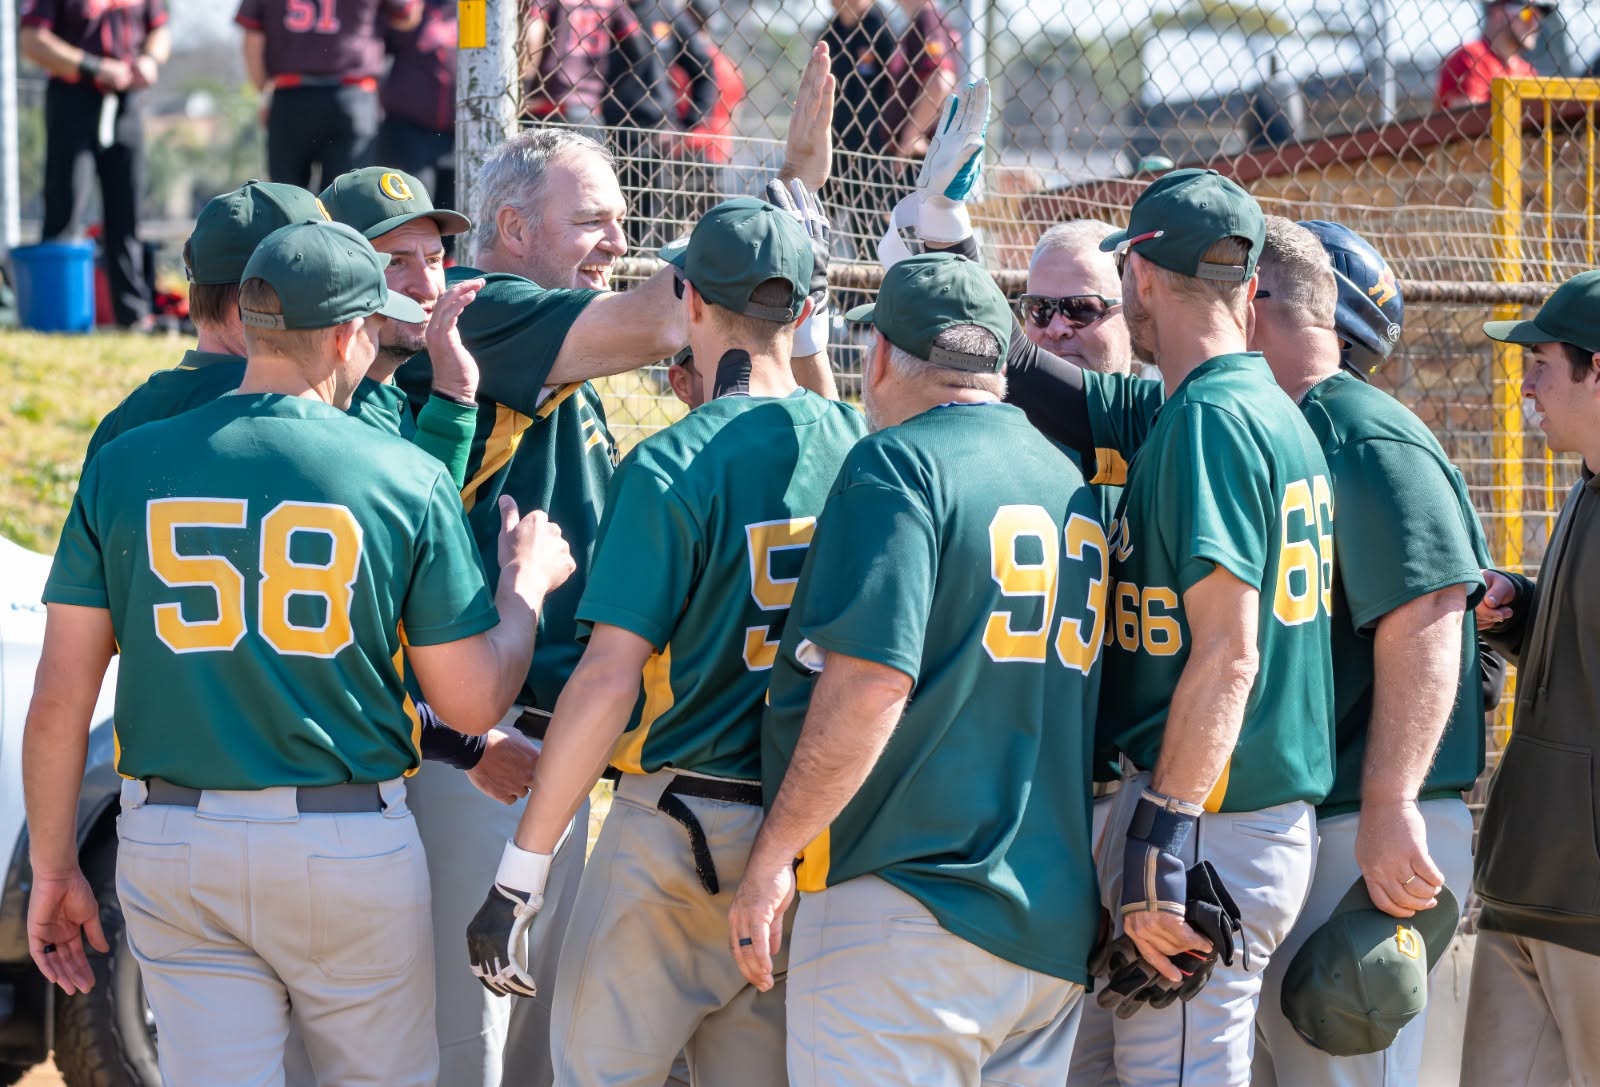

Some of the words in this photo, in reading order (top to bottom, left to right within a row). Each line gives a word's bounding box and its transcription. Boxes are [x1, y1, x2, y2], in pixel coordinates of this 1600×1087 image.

[284, 0, 340, 33] 51
[380, 172, 414, 201] G
[146, 496, 363, 659] 58
[981, 504, 1109, 677] 93
[1273, 474, 1334, 626] 66
